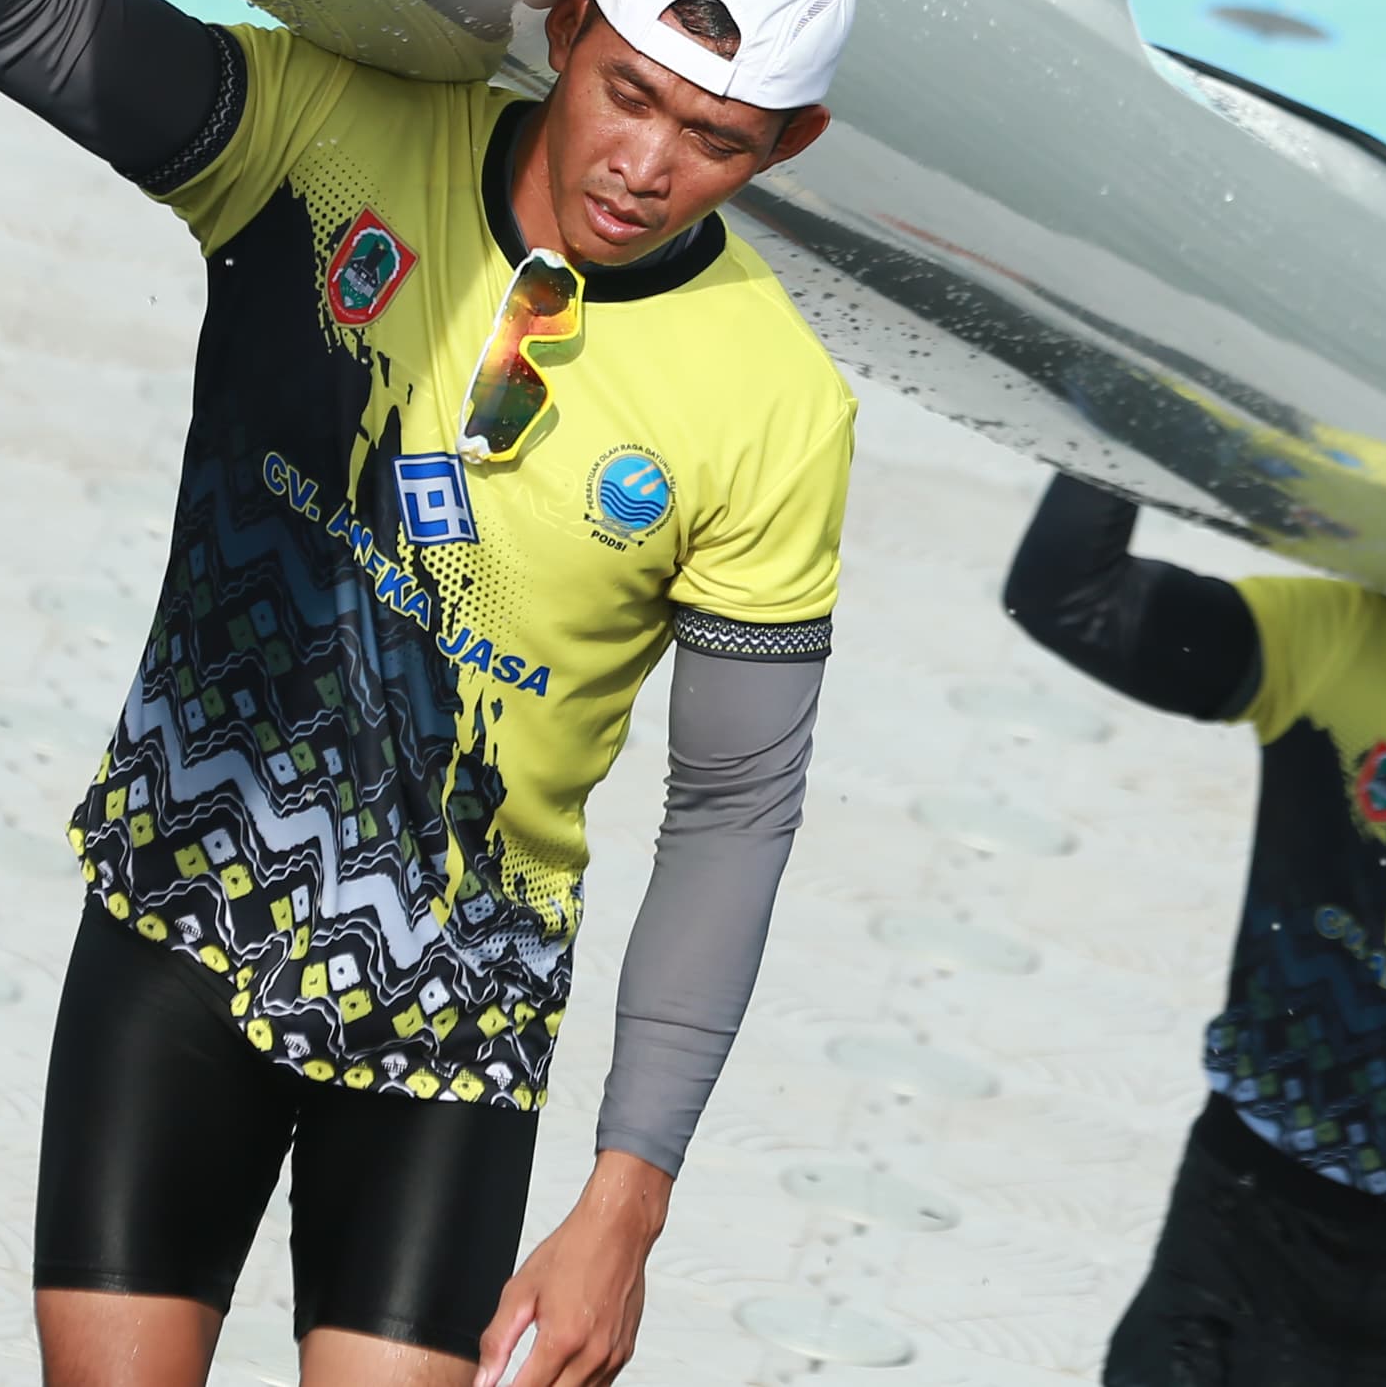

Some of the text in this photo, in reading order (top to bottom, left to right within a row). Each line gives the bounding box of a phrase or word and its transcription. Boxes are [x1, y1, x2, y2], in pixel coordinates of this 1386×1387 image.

[585, 462, 602, 511] PERSATUAN
[598, 446, 620, 462] OLAH
[620, 443, 644, 452] RAGA
[644, 447, 671, 475] DAYUNG
[263, 451, 321, 522] CV.
[437, 627, 550, 697] JASA
[590, 529, 628, 553] PODSI
